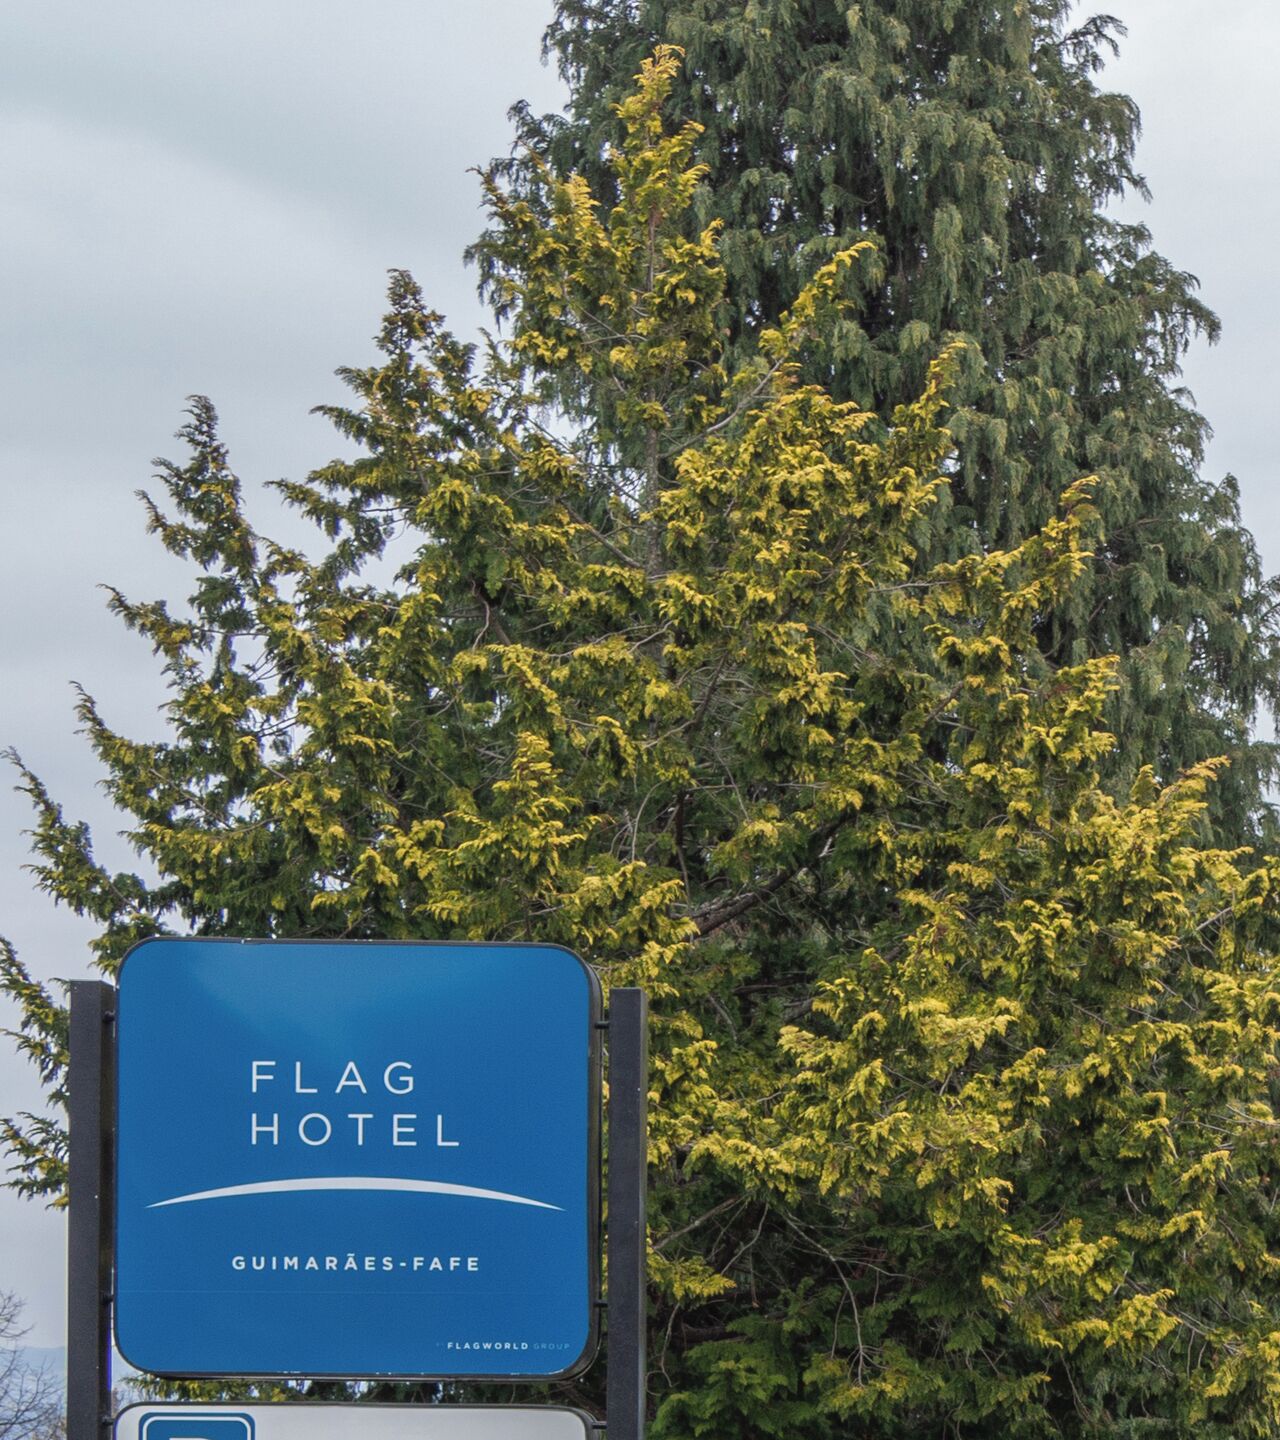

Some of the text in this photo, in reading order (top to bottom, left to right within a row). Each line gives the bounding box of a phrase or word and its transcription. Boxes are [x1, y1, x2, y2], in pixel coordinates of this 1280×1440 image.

[251, 1060, 414, 1095] FLAG
[251, 1112, 460, 1147] HOTEL
[231, 1252, 480, 1272] GUIMARÃES-FAFE
[447, 1342, 529, 1350] FLAGWORLD
[533, 1342, 571, 1350] GROUP
